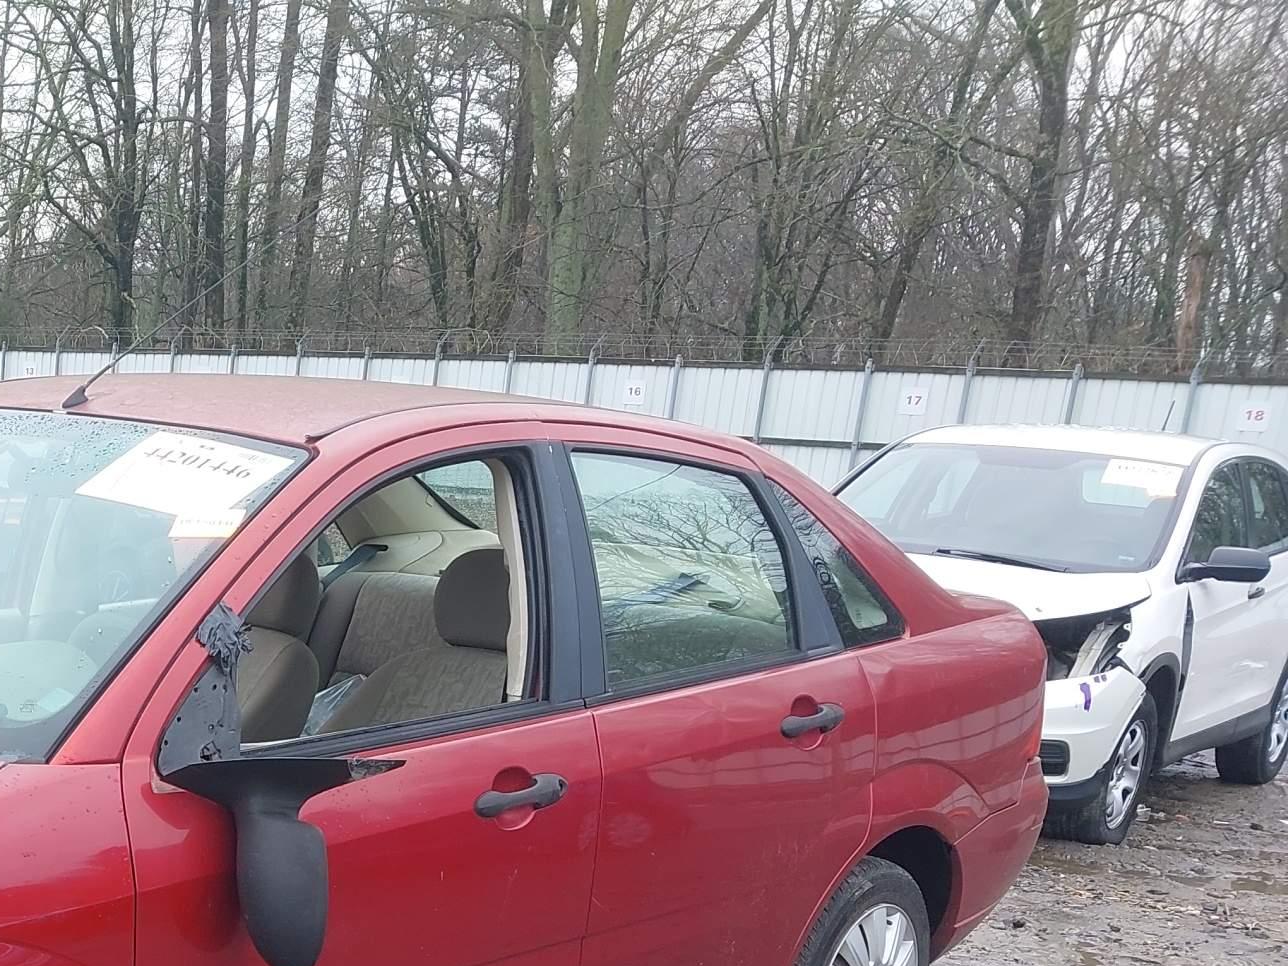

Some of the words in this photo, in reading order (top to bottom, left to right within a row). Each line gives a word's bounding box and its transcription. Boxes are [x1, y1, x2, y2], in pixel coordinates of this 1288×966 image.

[628, 386, 641, 396] 16
[906, 395, 923, 405] 17
[1245, 410, 1265, 421] 18
